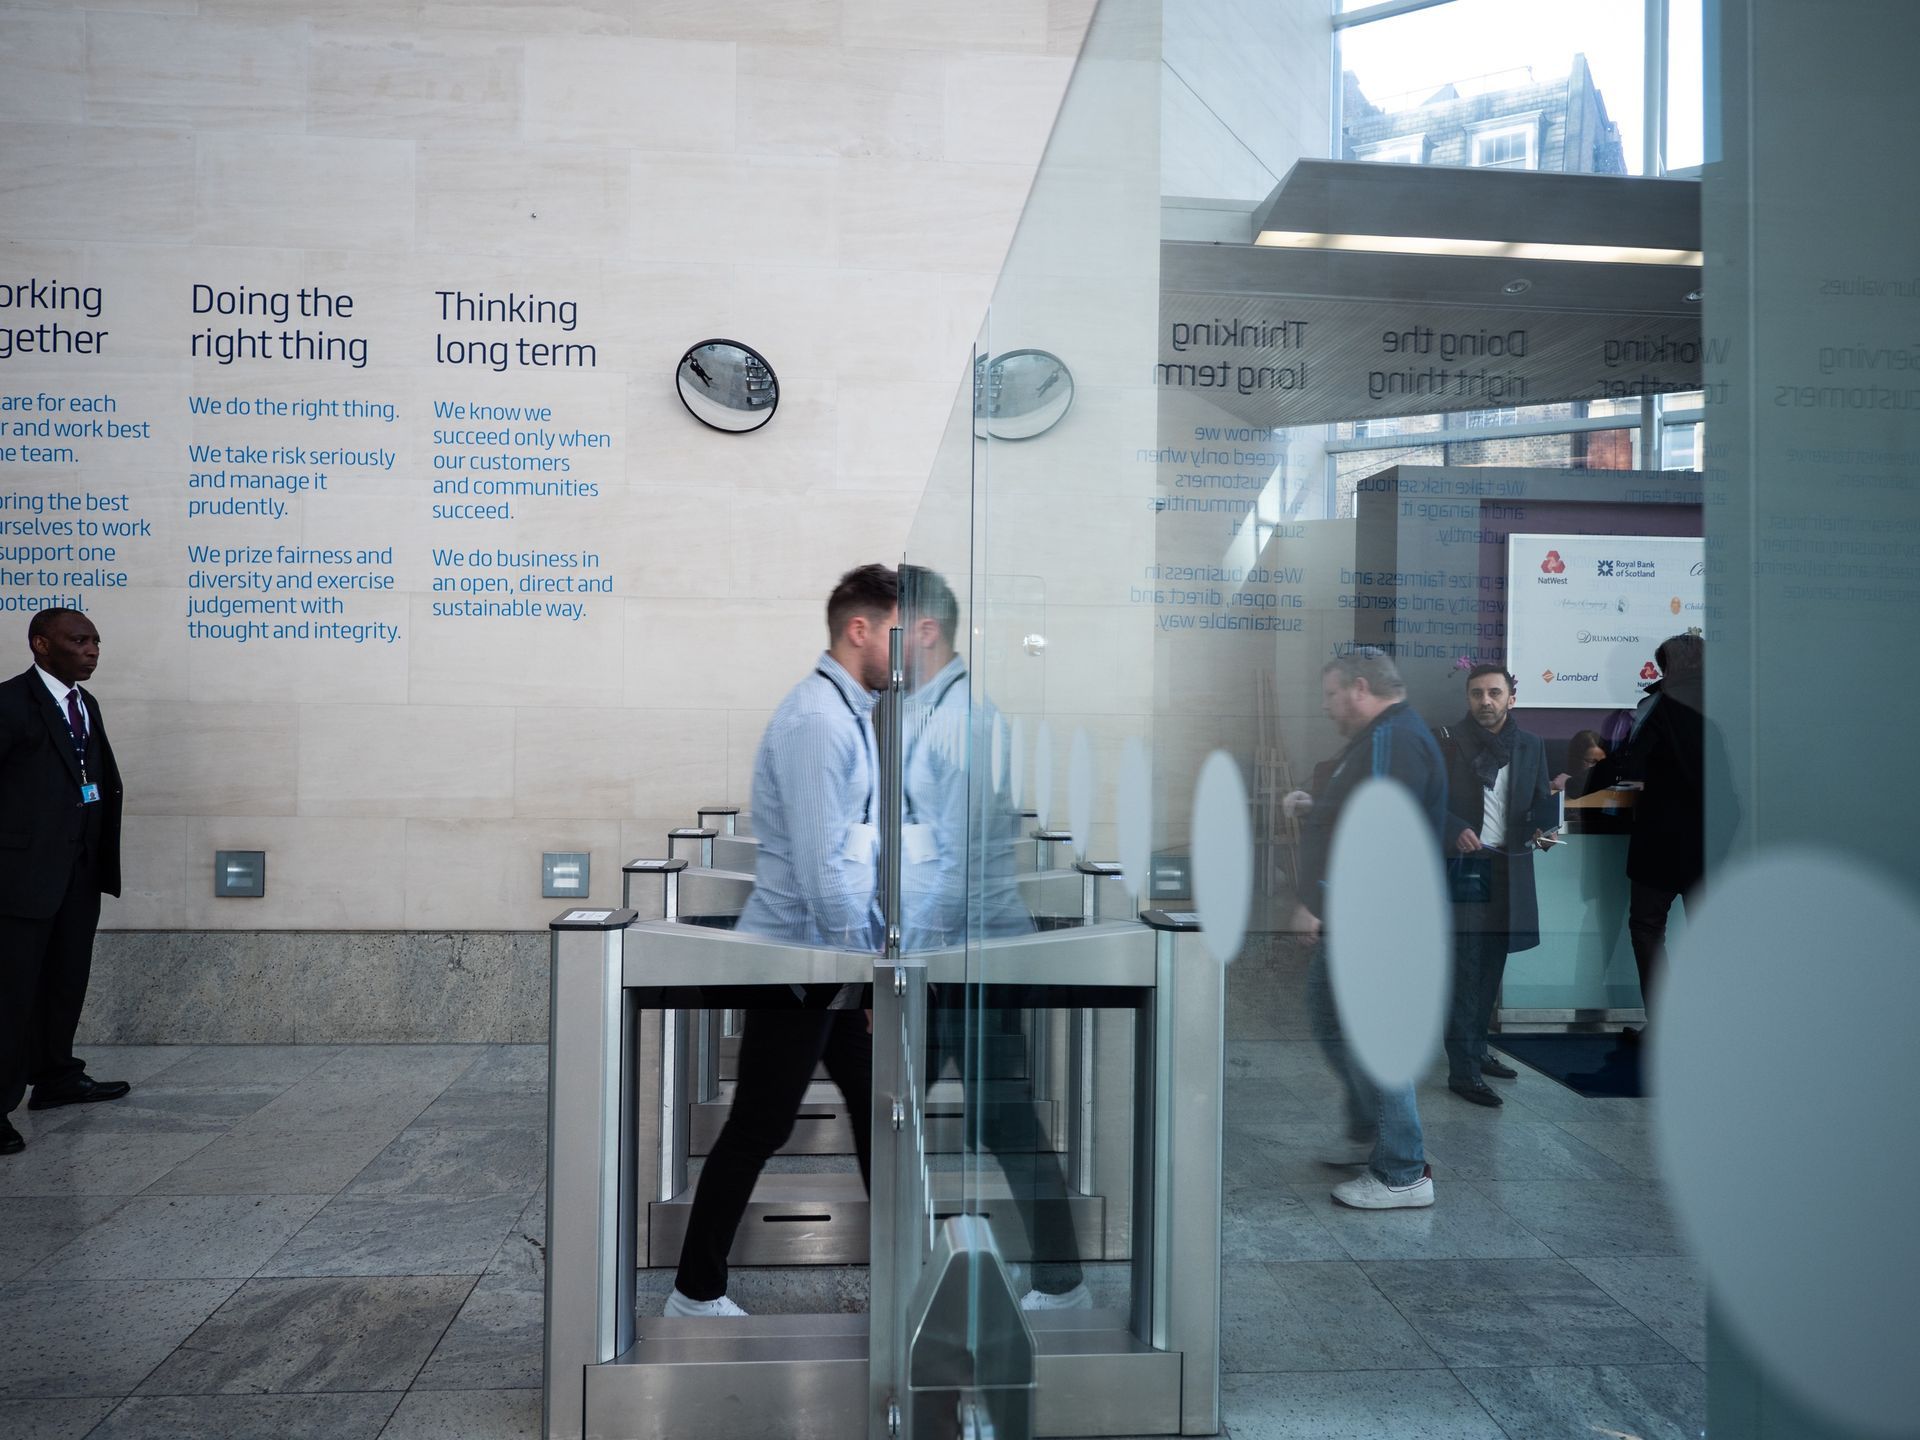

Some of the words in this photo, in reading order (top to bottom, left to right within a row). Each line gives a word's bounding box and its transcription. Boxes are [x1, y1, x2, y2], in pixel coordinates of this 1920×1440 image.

[193, 284, 288, 323] Doing
[297, 287, 353, 318] the
[435, 291, 577, 331] Thinking
[192, 328, 272, 365] right
[279, 330, 367, 368] thing
[437, 334, 507, 372] long
[515, 338, 596, 367] term
[37, 393, 65, 411] for
[70, 395, 116, 412] each
[189, 397, 221, 414] We
[226, 397, 250, 415] do
[254, 398, 287, 416] the
[292, 399, 339, 420] right
[342, 400, 399, 422] thing.
[434, 401, 465, 419] We
[470, 402, 521, 420] know
[524, 408, 551, 421] we
[13, 418, 49, 436] and
[54, 420, 102, 437] work
[108, 420, 150, 438] best
[434, 428, 509, 445] succeed
[515, 429, 555, 450] only
[559, 429, 610, 447] when
[20, 445, 78, 462] team.
[189, 445, 221, 463] We
[225, 446, 267, 463] take
[273, 447, 306, 464] risk
[310, 448, 395, 470] seriously
[434, 455, 465, 469] our
[470, 454, 570, 471] customers
[189, 470, 225, 488] and
[231, 475, 309, 493] manage
[315, 473, 327, 490] it
[433, 477, 468, 494] and
[474, 480, 598, 496] communities
[47, 493, 81, 510] the
[87, 493, 129, 511] best
[189, 497, 288, 519] prudently.
[433, 502, 514, 519] succeed.
[77, 519, 97, 536] to
[102, 519, 151, 536] work
[79, 548, 115, 561] one
[188, 545, 220, 563] We
[226, 546, 272, 567] prize
[276, 546, 352, 564] fairness
[357, 547, 392, 564] and
[432, 549, 464, 566] We
[469, 549, 492, 566] do
[497, 549, 577, 567] business
[583, 550, 599, 567] in
[1616, 560, 1636, 569] Royal
[37, 569, 58, 586] to
[64, 568, 127, 587] realise
[189, 570, 272, 592] diversity
[277, 571, 312, 589] and
[317, 572, 394, 589] exercise
[433, 578, 455, 591] an
[461, 578, 513, 595] open,
[520, 575, 574, 592] direct
[578, 575, 612, 592] and
[1538, 577, 1568, 585] NatWest
[186, 595, 297, 617] judgement
[301, 596, 343, 614] with
[433, 599, 541, 616] sustainable
[546, 603, 586, 621] way.
[188, 620, 269, 642] thought
[273, 621, 309, 639] and
[315, 622, 400, 643] integrity.
[1557, 672, 1598, 682] Lombard
